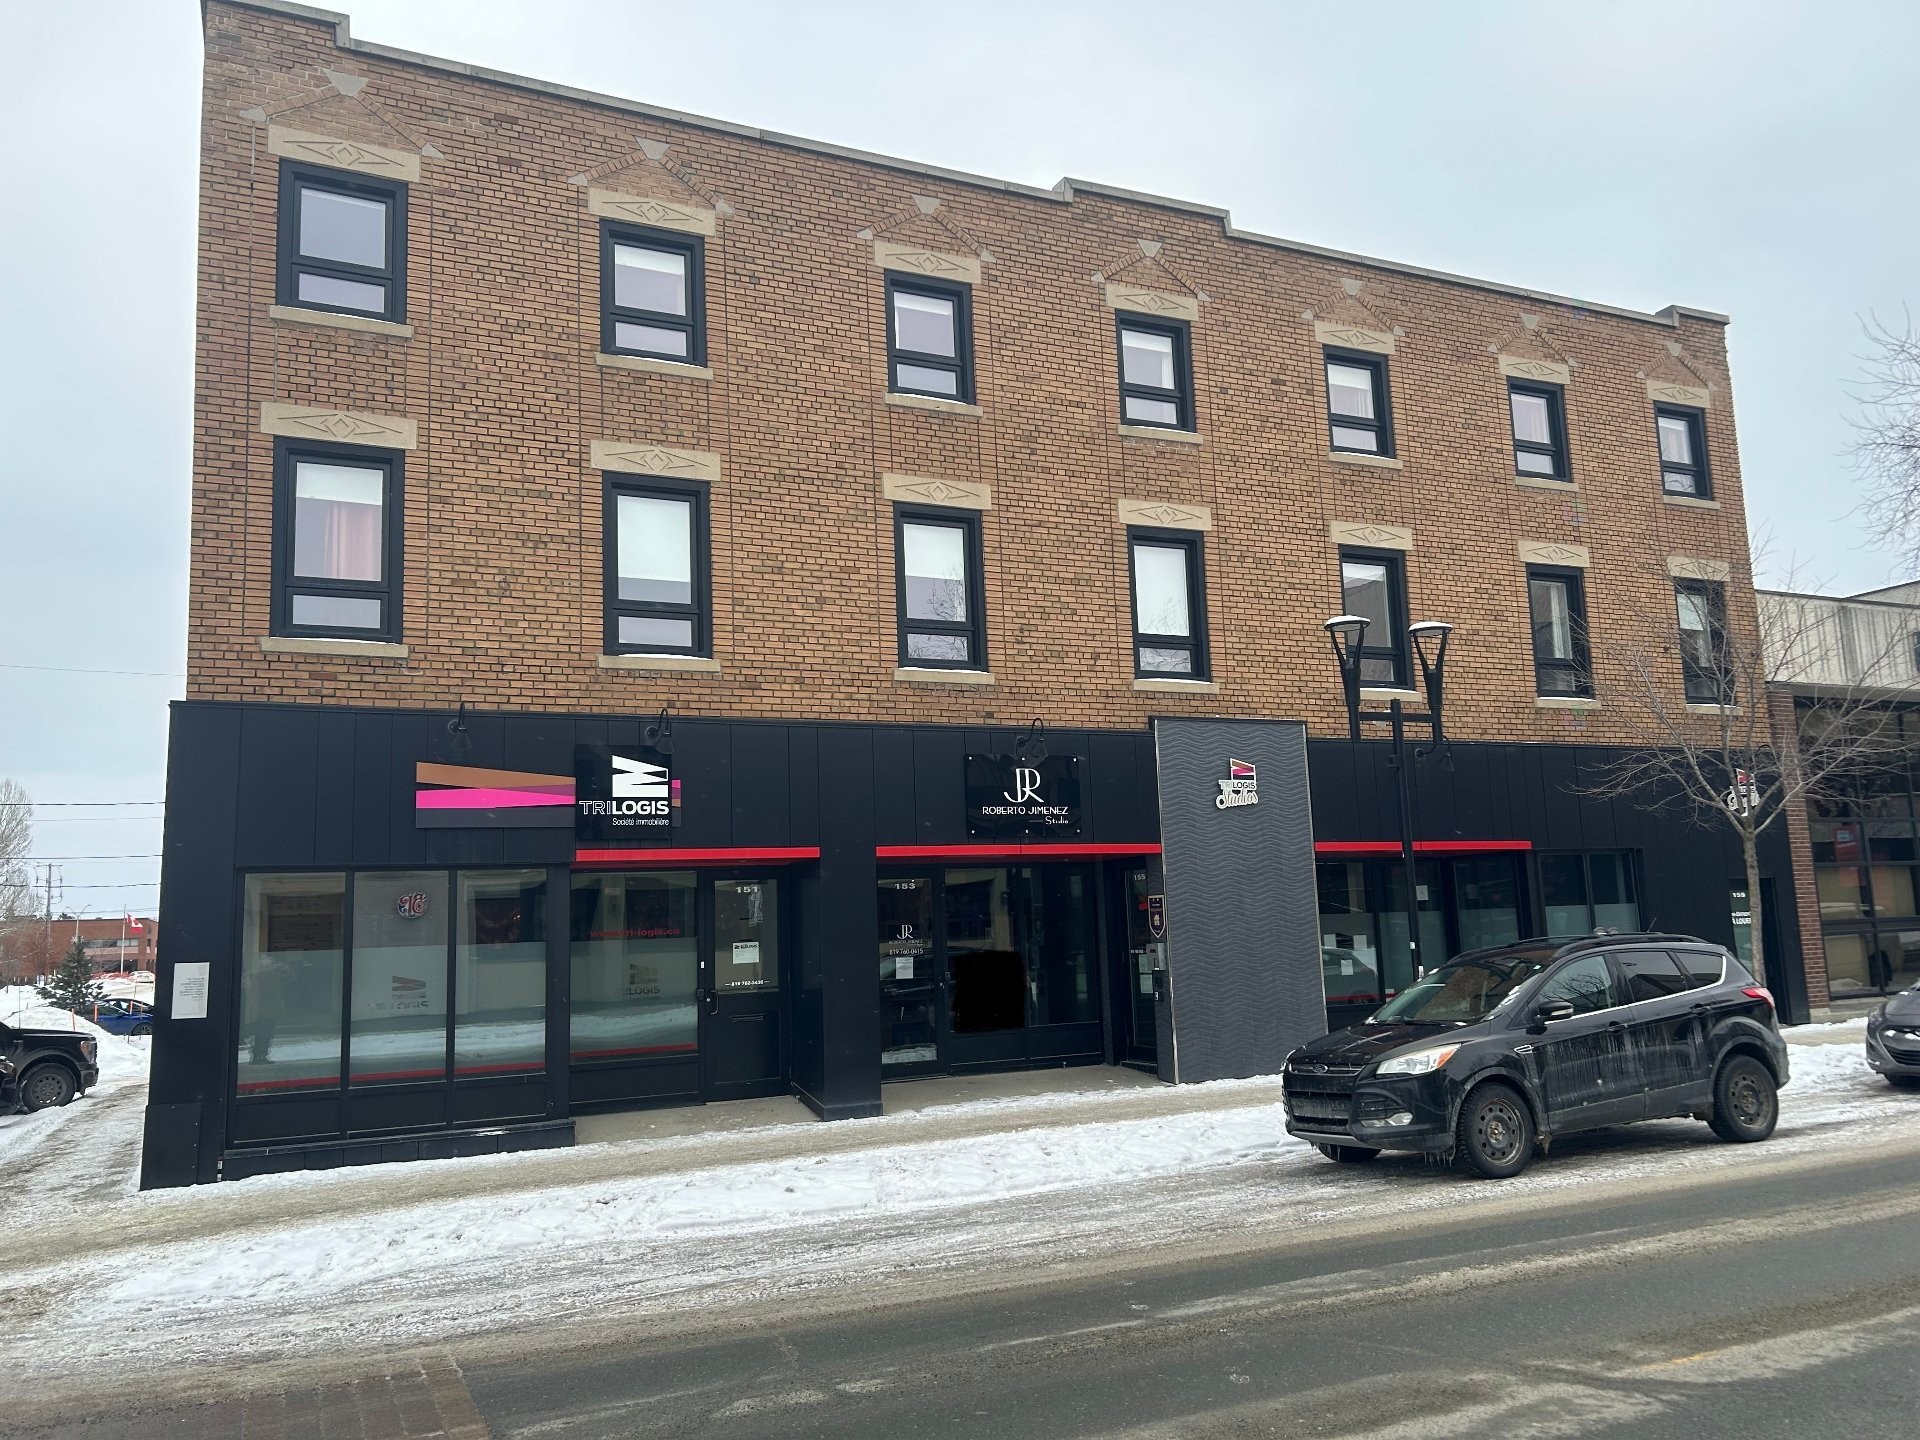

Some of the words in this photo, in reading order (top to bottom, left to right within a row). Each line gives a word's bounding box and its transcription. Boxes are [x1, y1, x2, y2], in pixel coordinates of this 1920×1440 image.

[1003, 767, 1045, 803] JR
[579, 800, 670, 815] TRILOGIS
[982, 806, 1026, 815] ROBERTO
[1028, 806, 1069, 815] JIMENEZ
[612, 817, 635, 826] Société
[635, 817, 670, 826] immobilière
[1045, 816, 1069, 825] Studio
[735, 885, 758, 894] 151
[1736, 917, 1752, 925] LOUE
